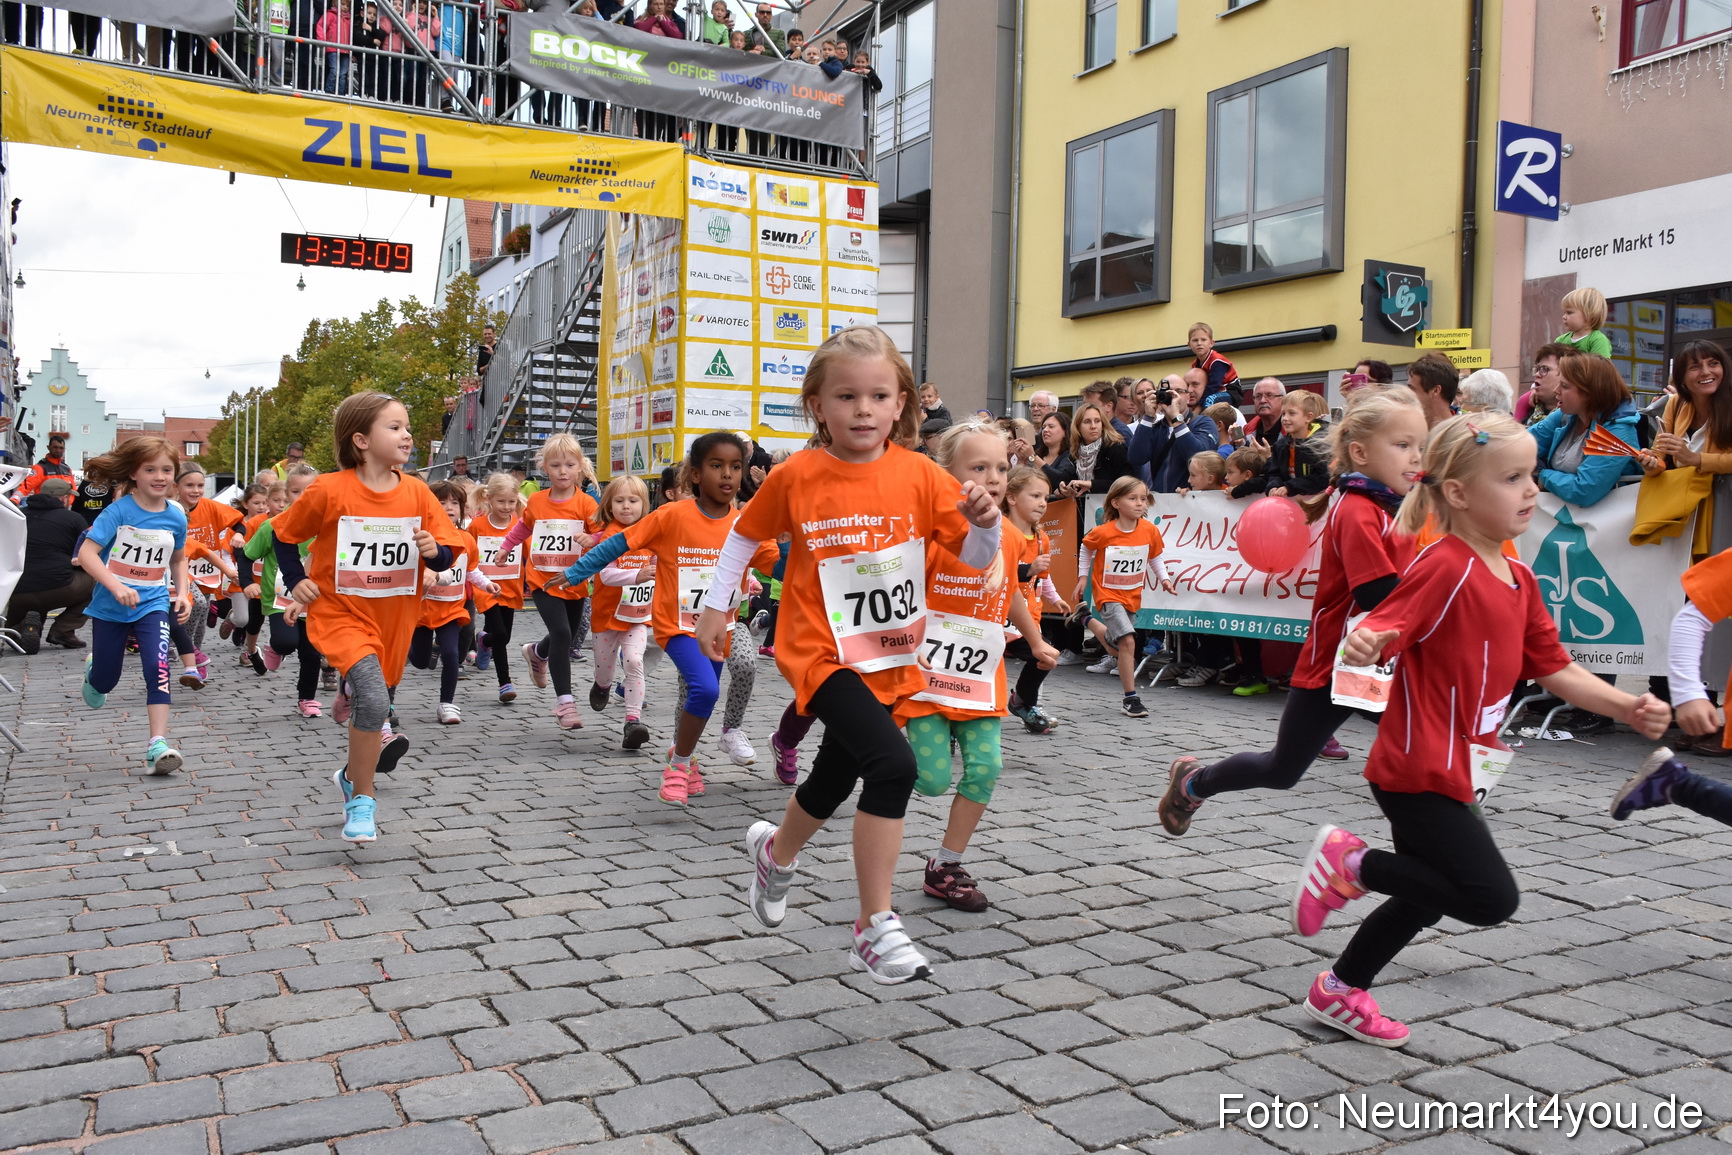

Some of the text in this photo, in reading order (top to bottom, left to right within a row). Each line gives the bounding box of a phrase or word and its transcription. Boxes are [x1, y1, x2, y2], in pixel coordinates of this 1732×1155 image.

[532, 31, 648, 76] BOCK
[529, 56, 652, 86] inspired by smart concepts
[667, 60, 846, 107] OFFICE INDUSTRY LOUNGE
[698, 86, 822, 120] www.bockonline.de
[45, 104, 213, 141] Neumarkter Stadtlauf
[302, 117, 453, 179] ZIEL
[529, 169, 656, 189] Neumarkter Stadtlauf
[721, 192, 748, 202] energie
[760, 240, 786, 249] stadtwerke
[761, 229, 799, 244] swn
[1559, 228, 1675, 263] Unterer Markt 15
[793, 274, 813, 283] CODE
[793, 282, 816, 292] CLINIC
[706, 316, 750, 327] VARIOTEC
[776, 316, 806, 331] Burgis
[1434, 339, 1460, 347] ausgabe
[762, 356, 807, 375] RÖD
[1448, 355, 1482, 364] Toiletten
[801, 514, 885, 535] Neumarkter
[539, 535, 573, 552] 7231
[806, 530, 870, 552] Stadtlauf
[120, 542, 164, 565] 7114
[350, 542, 409, 566] 7150
[677, 546, 722, 556] Neumarkt
[188, 563, 214, 575] 148
[677, 556, 719, 567] Stadtlauf
[869, 556, 903, 574] BOCK
[1112, 558, 1143, 573] 7212
[130, 568, 149, 577] Kajsa
[366, 575, 392, 584] Emma
[935, 572, 992, 585] Neumarkt
[933, 584, 985, 599] Stadtlauf
[994, 576, 1009, 623] BAMBIN
[844, 579, 918, 627] 7032
[1153, 613, 1215, 629] Service-Line:
[951, 624, 984, 637] BOCK
[880, 633, 915, 648] Paula
[157, 620, 171, 694] AWESOME
[925, 638, 989, 675] 7132
[1570, 649, 1644, 665] Service GmbH
[929, 676, 971, 694] Franziska
